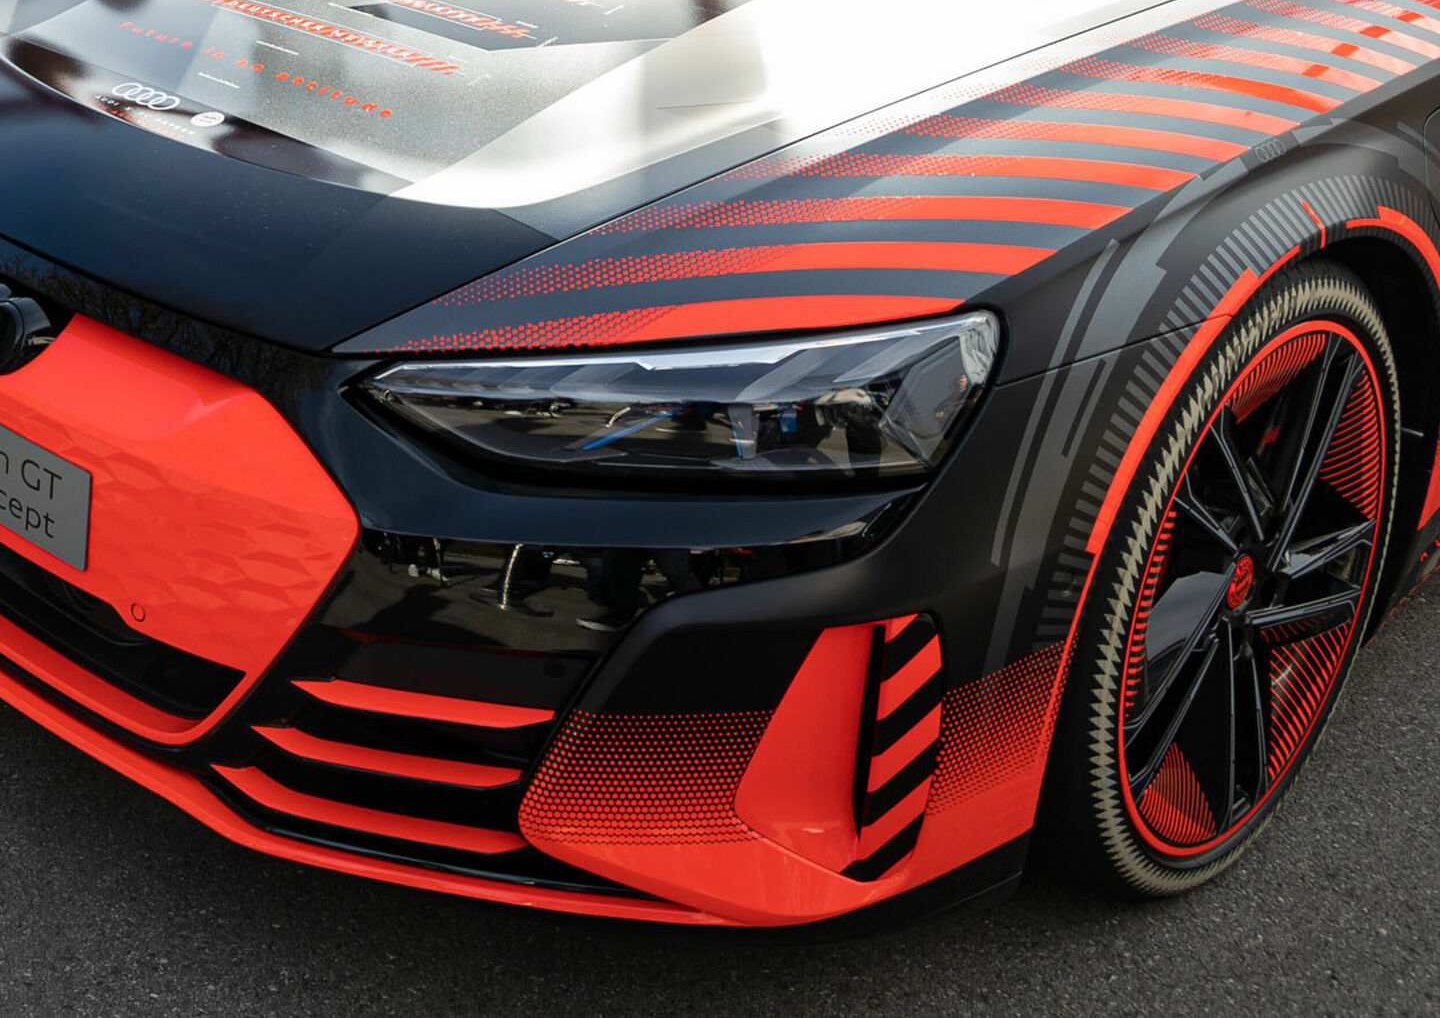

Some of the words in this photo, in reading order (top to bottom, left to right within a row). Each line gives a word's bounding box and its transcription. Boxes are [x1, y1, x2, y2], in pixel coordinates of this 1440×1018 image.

[119, 21, 193, 49] Future
[275, 71, 393, 119] attitude
[21, 459, 63, 500] GT
